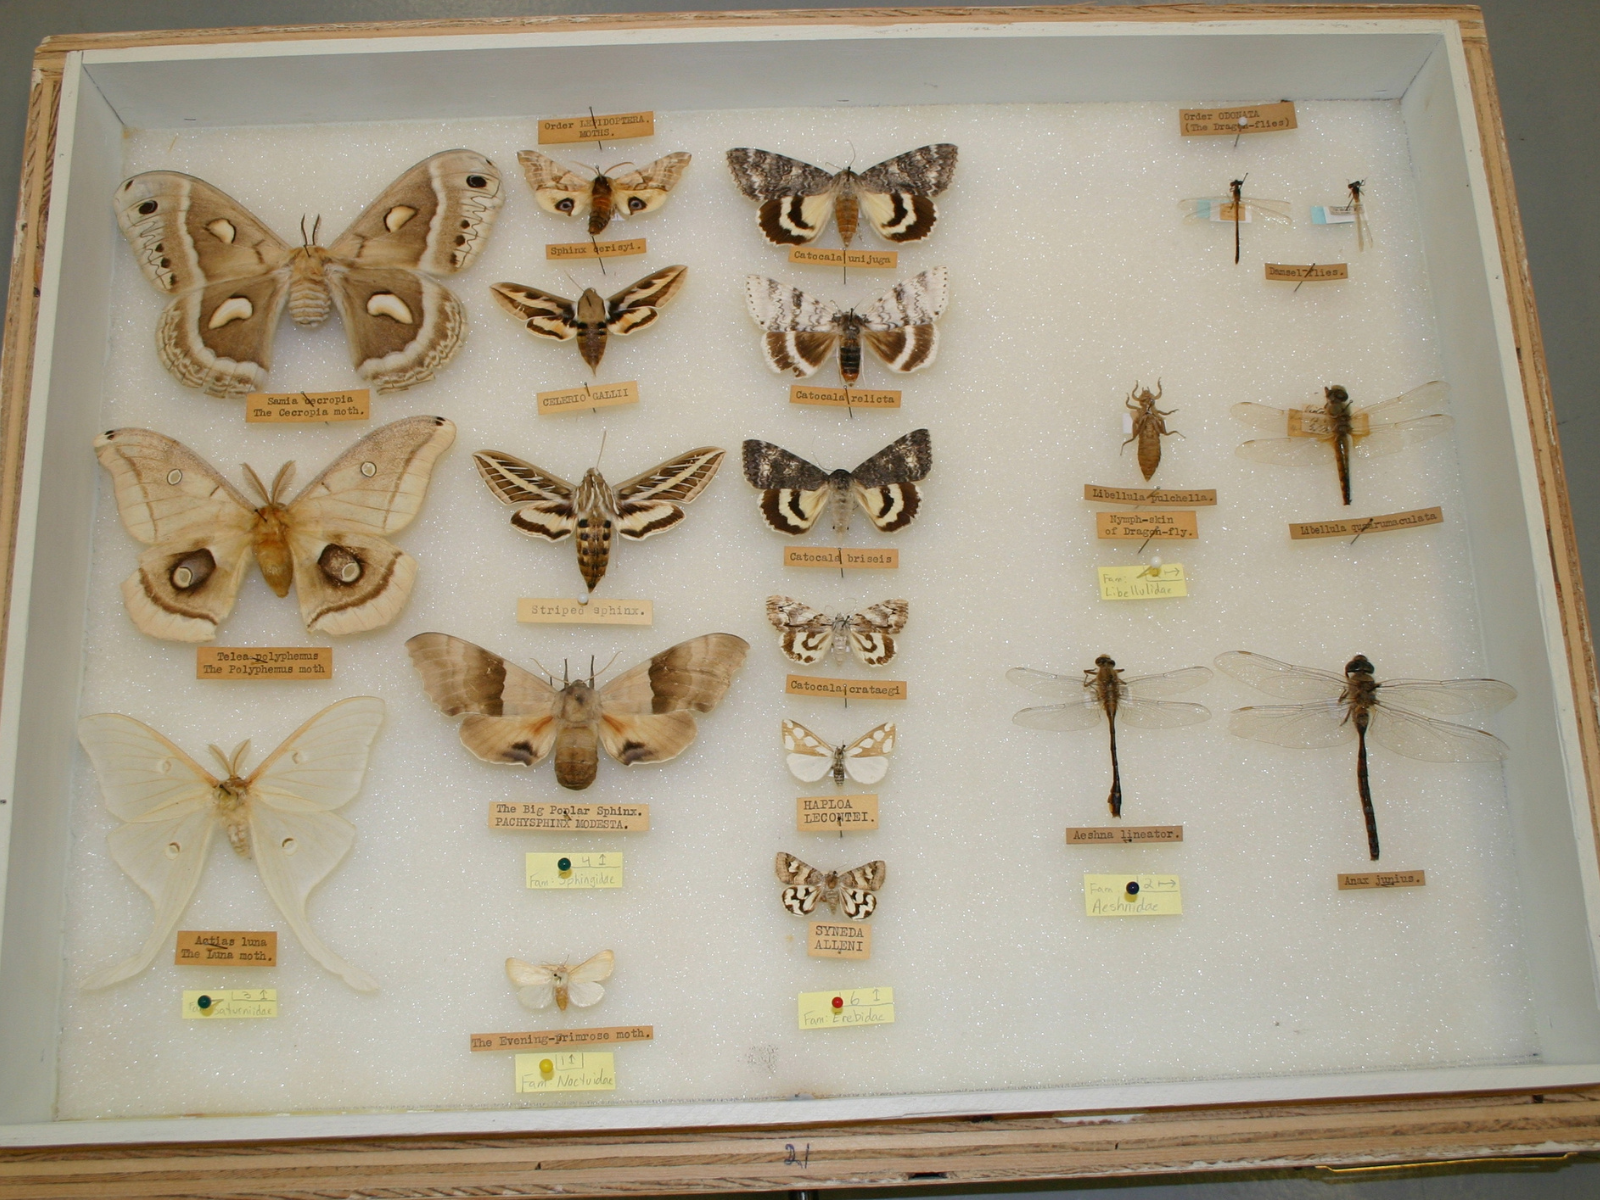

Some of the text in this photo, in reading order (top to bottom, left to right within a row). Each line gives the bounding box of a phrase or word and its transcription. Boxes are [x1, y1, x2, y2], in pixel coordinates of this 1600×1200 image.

[1184, 110, 1260, 121] Order ODONATA
[544, 116, 649, 130] Order LEPIDOPTERA.
[1185, 119, 1290, 132] (The Dragn-flies)
[579, 128, 614, 138] MOTHS.
[551, 246, 587, 255] Sphinx
[794, 251, 891, 265] Catocala unijuga
[268, 395, 353, 405] Samia cecropia
[543, 388, 628, 406] CELERIO GALLII
[796, 390, 895, 403] Catocala relicta
[254, 406, 364, 418] The Cecropia moth.
[1093, 489, 1213, 503] Libellula pulchella.
[1110, 515, 1174, 525] Nymph-skin
[1105, 527, 1117, 535] of
[1301, 522, 1346, 535] Libellula
[790, 553, 892, 563] Catocala briseis
[593, 605, 644, 617] sphinx.
[217, 652, 318, 663] Telea polyphemus
[203, 665, 325, 675] The Polyphemus moth
[791, 680, 900, 696] Catocala crataegi
[497, 804, 642, 817] The Big Poplar Sphinx.
[804, 799, 852, 810] HAPLOA
[804, 811, 874, 823] LECONTEI.
[495, 817, 628, 830] PACHYSPHINX MODESTA.
[1073, 830, 1179, 840] Aeshna lineator.
[1144, 879, 1153, 889] 2
[1345, 874, 1420, 886] Anax junius.
[816, 925, 864, 938] SYNEDA
[195, 936, 267, 947] Actias luna
[815, 940, 863, 951] ALLENI
[181, 949, 272, 962] The Luna moth.
[850, 991, 860, 1005] 6
[472, 1029, 650, 1048] The Evening-primrose moth.
[784, 1143, 809, 1169] 21
